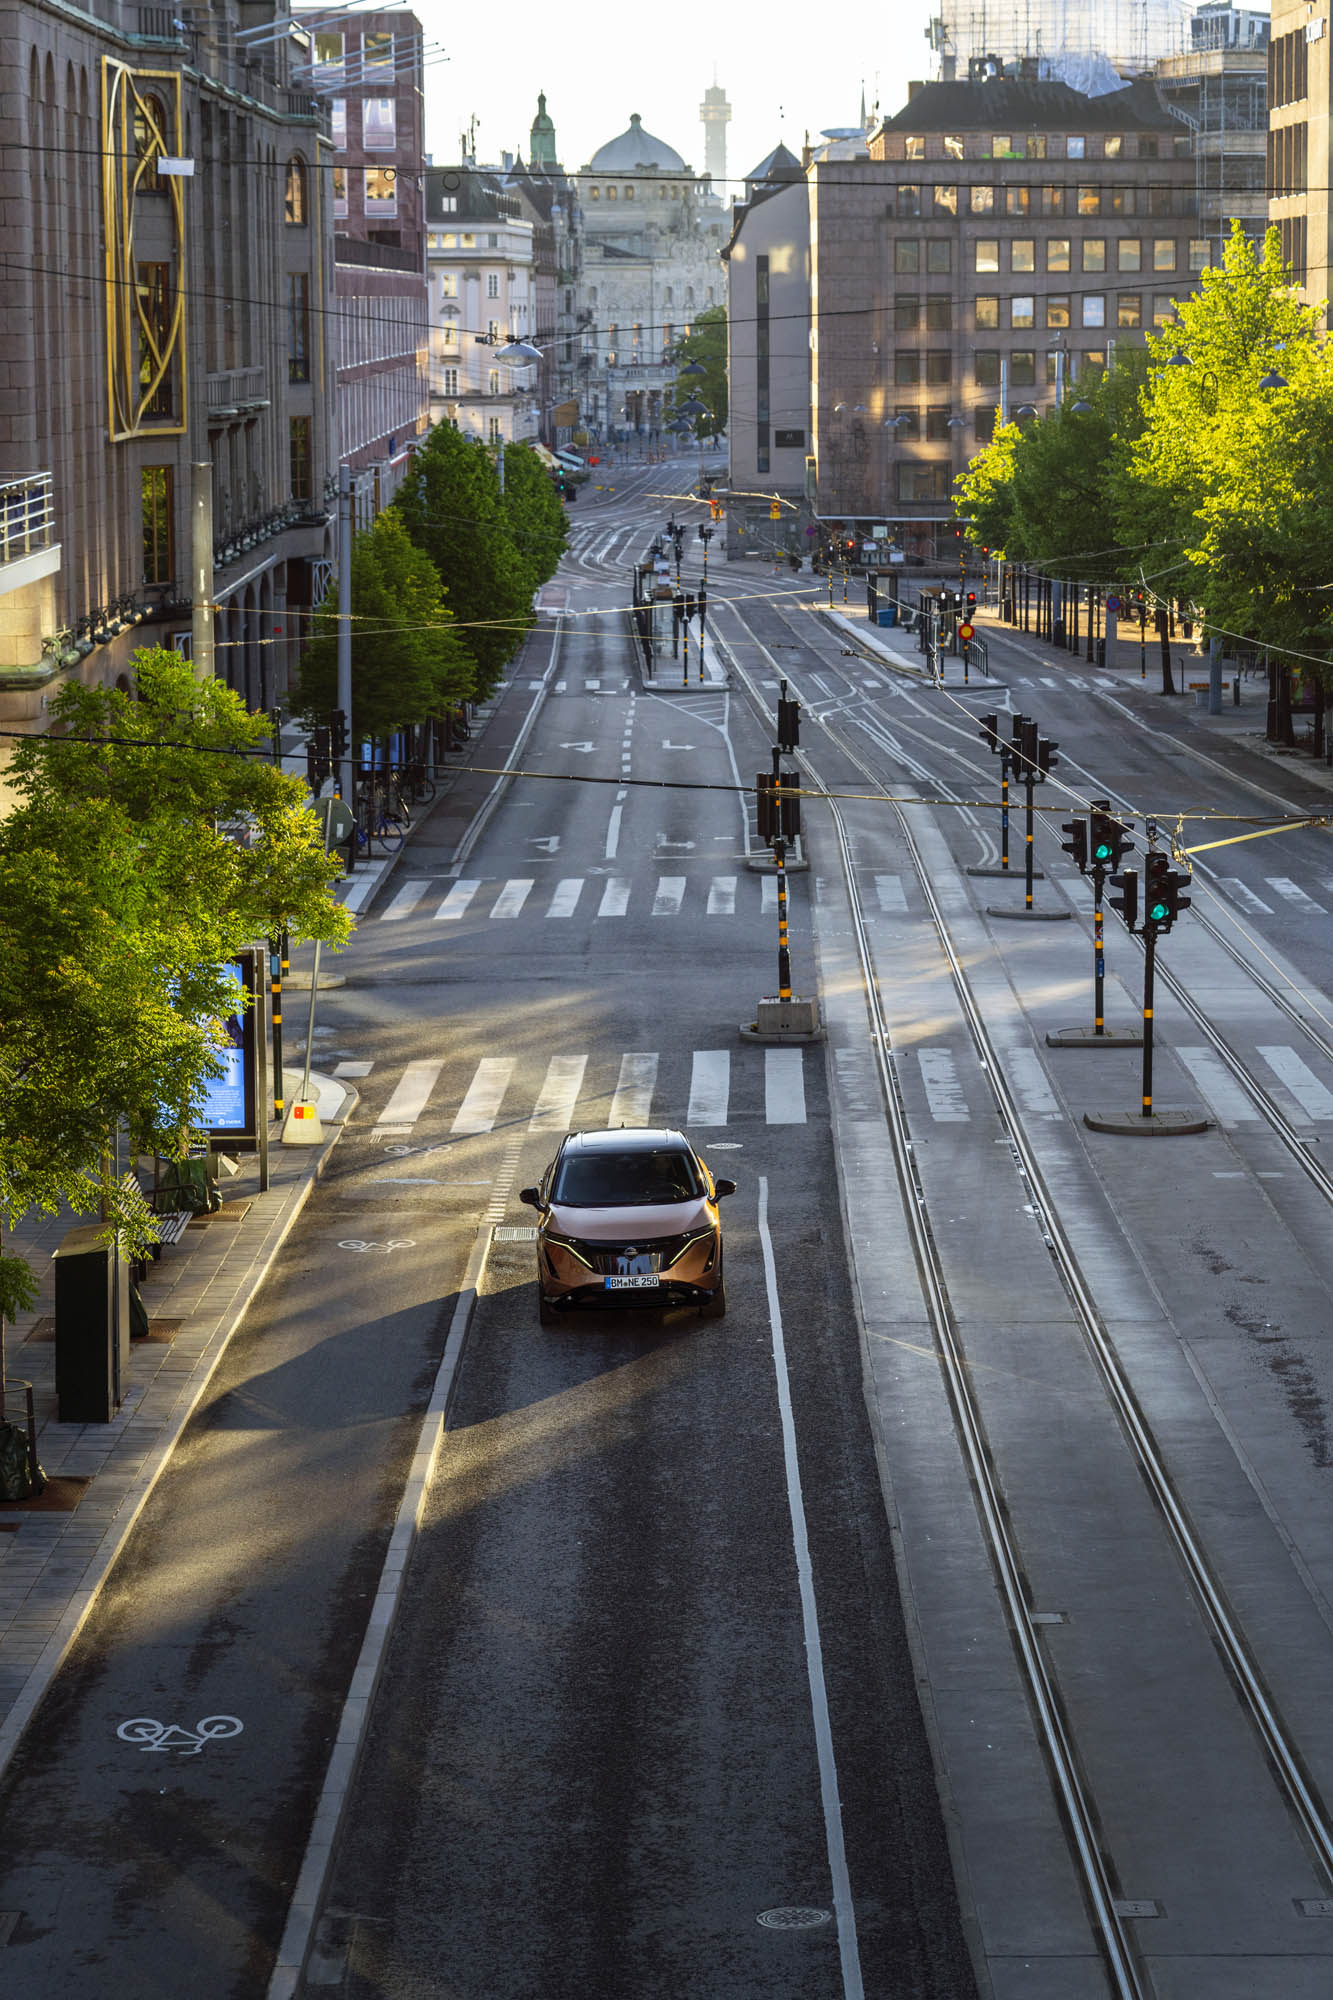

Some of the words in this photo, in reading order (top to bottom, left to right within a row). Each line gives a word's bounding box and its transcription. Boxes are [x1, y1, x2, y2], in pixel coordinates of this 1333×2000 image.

[611, 1279, 623, 1287] BM
[628, 1278, 640, 1286] NE
[641, 1277, 657, 1286] 250
